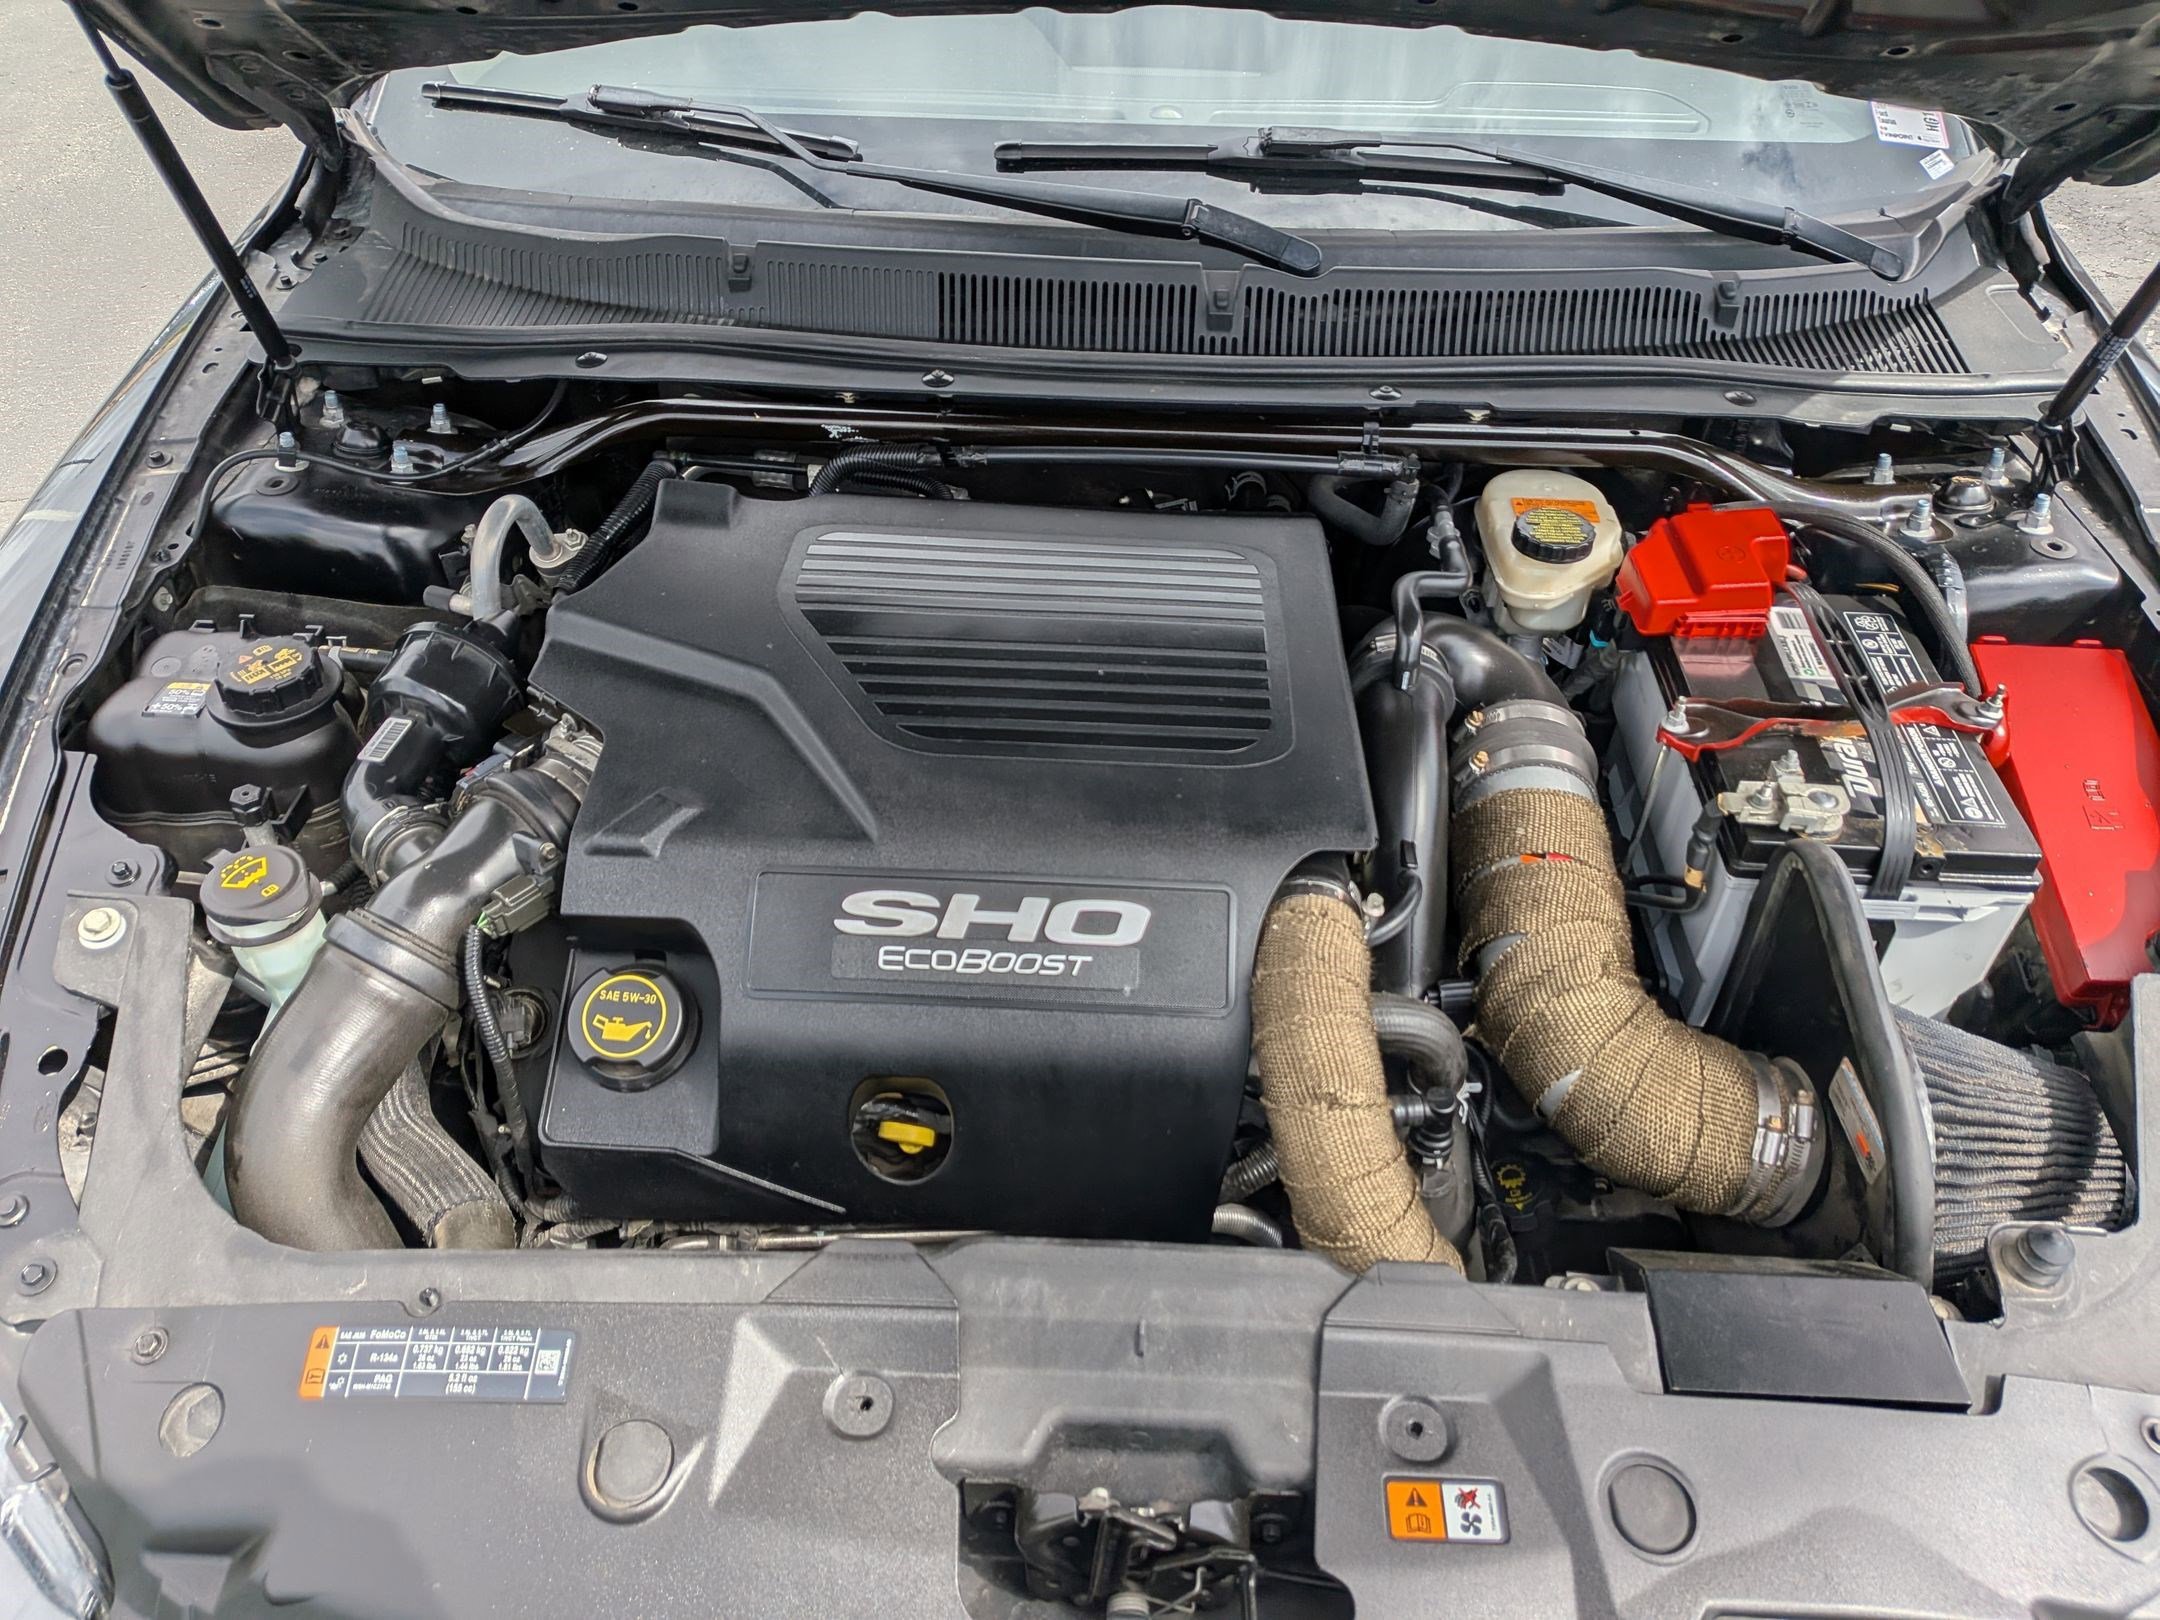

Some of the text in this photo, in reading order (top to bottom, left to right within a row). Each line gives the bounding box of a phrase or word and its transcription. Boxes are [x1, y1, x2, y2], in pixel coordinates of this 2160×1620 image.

[1833, 736, 1879, 799] Dural
[834, 889, 1151, 947] SHO
[599, 989, 657, 1005] SAE 5W-30
[370, 1328, 407, 1340] FoMoCo
[412, 1344, 444, 1356] 0.737 kg
[476, 1345, 487, 1357] kg
[519, 1345, 530, 1358] kg
